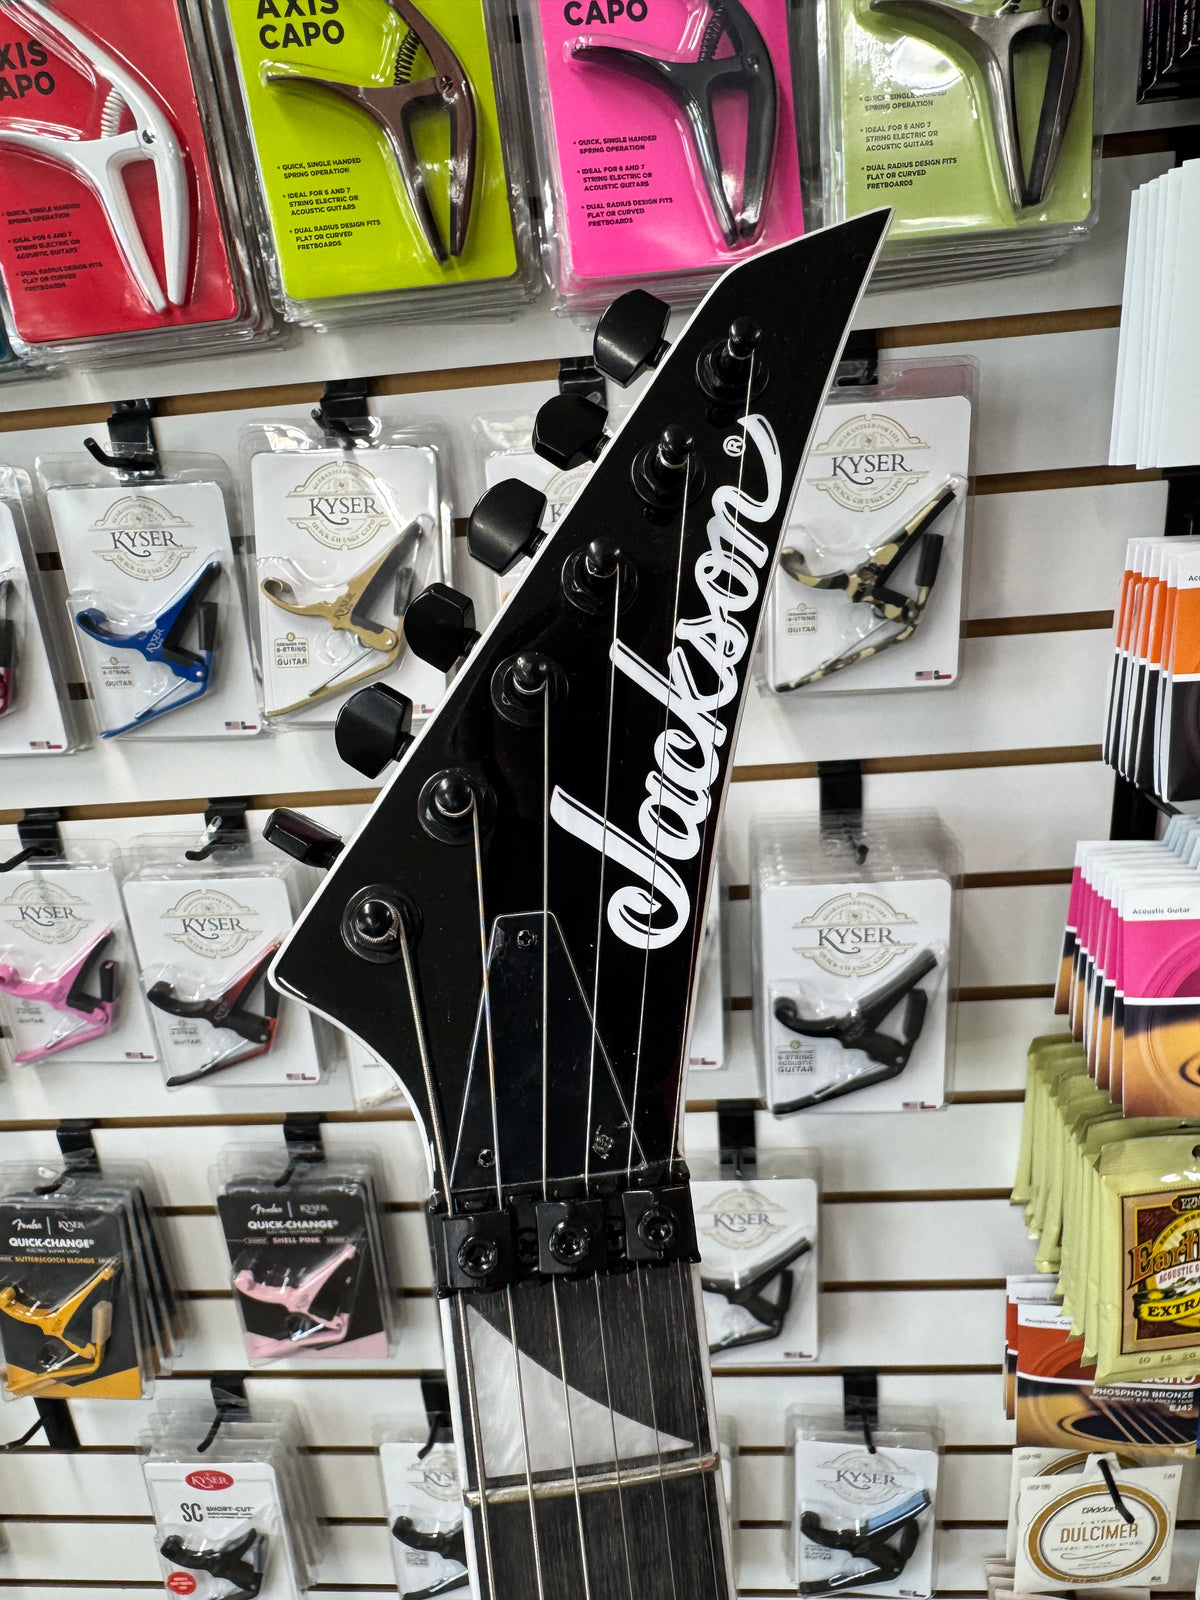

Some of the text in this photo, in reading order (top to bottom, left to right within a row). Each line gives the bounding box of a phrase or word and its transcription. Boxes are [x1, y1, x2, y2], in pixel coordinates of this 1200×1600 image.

[256, 0, 339, 19] AXIS
[563, 0, 648, 26] CAPO
[259, 19, 345, 49] CAPO
[0, 39, 48, 71] XIS
[0, 71, 55, 101] APO
[892, 100, 933, 109] OPERATION
[893, 132, 926, 140] ELECTRIC
[866, 140, 933, 152] ACOUSTIC GUITARS
[307, 160, 331, 168] SINGLE
[310, 168, 349, 176] OPERATION
[887, 162, 913, 170] RADIUS
[915, 159, 940, 167] DESIGN
[867, 180, 913, 189] FRETBOARDS
[289, 199, 314, 207] STRING
[316, 196, 348, 205] ELECTRIC
[291, 204, 356, 215] ACOUSTIC GUITARS
[340, 221, 365, 229] DESIGN
[325, 231, 352, 239] CURVED
[298, 240, 342, 250] FRETBOARDS
[832, 453, 913, 486] KYSER
[308, 497, 384, 526] KYSER
[110, 530, 183, 558] KYSER
[277, 658, 308, 666] GUITAR
[550, 413, 781, 950] Jackson
[18, 906, 83, 927] KYSER
[181, 917, 250, 940] KYSER
[817, 927, 900, 955] KYSER
[713, 1213, 773, 1233] KYSER
[1127, 1228, 1200, 1290] Eart
[1158, 1264, 1193, 1284] ACOUSTIC
[1092, 1387, 1149, 1398] PHOSPHOR
[1151, 1390, 1194, 1399] BRONZE
[191, 1474, 230, 1489] KYSER
[835, 1470, 901, 1490] KYSER
[180, 1503, 204, 1522] SC
[1060, 1523, 1138, 1543] DULCIMER
